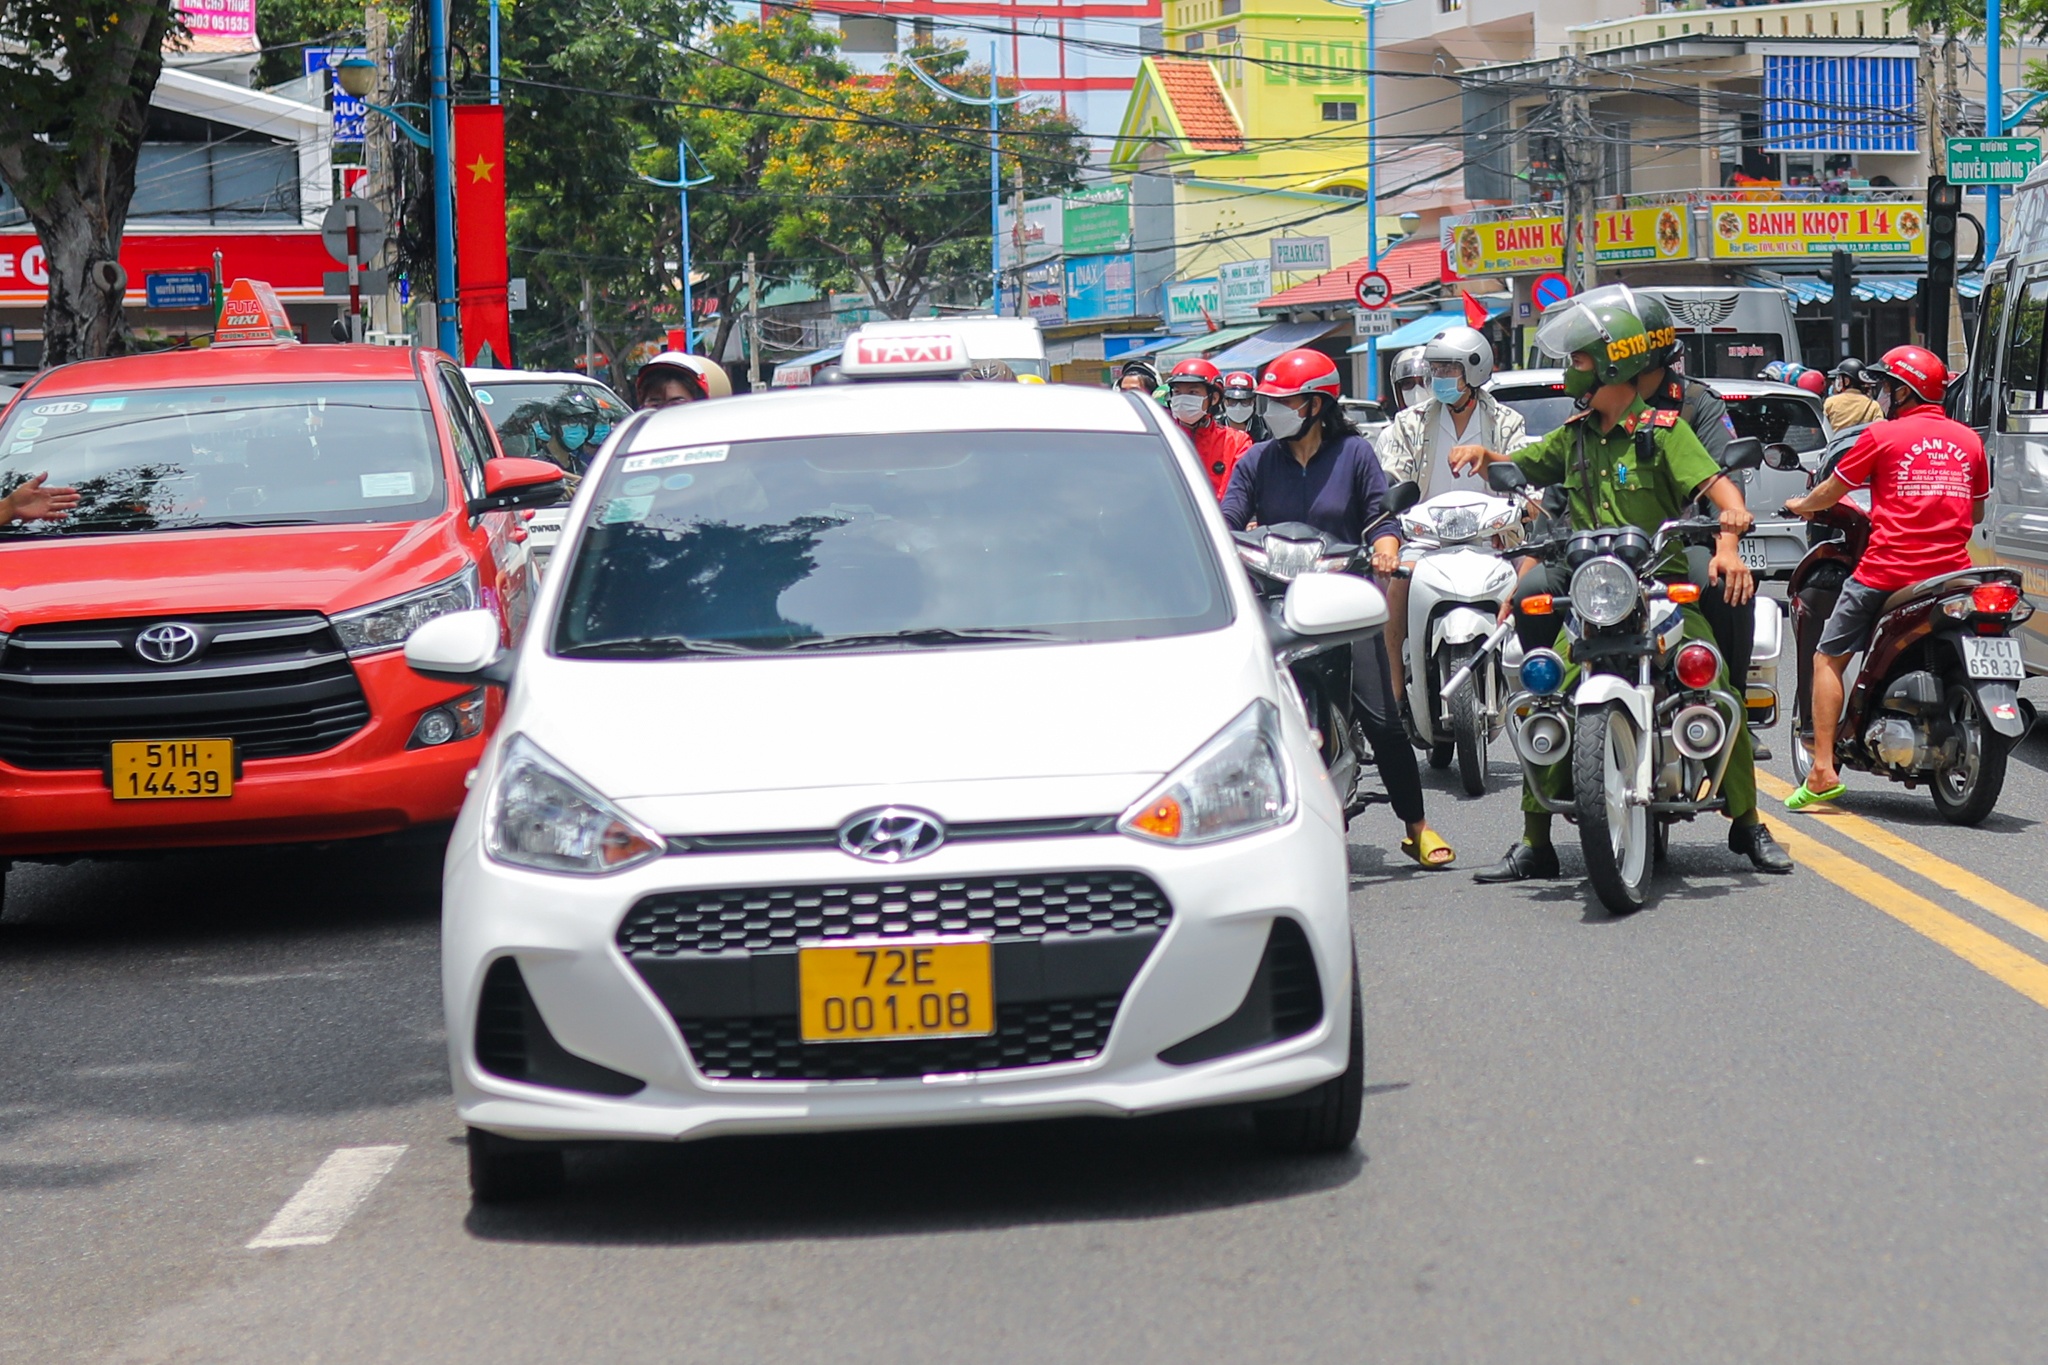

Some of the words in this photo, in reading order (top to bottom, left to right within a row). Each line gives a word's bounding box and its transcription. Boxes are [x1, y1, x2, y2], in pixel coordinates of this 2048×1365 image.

[1980, 140, 2009, 152] ĐƯỜNG
[1951, 156, 1988, 179] NGUYỄN
[1990, 156, 2024, 179] TRƯỜNG
[1496, 222, 1545, 252] BÁNH
[1607, 213, 1635, 243] 14
[1747, 206, 1796, 236] BÁNH
[1802, 211, 1850, 242] KHỌT
[1856, 208, 1893, 236] 14
[1277, 243, 1325, 264] PHARMACY
[1076, 264, 1098, 286] INAX
[226, 300, 262, 315] FUTA
[1172, 288, 1201, 316] THUỐC
[226, 314, 261, 326] TAXI
[860, 336, 948, 363] TAXI
[1606, 332, 1648, 362] CS113
[37, 403, 82, 414] 0115
[1911, 437, 1943, 456] SẢN
[1972, 640, 2013, 658] 72-C1
[1970, 659, 2022, 677] 658.32
[146, 744, 197, 768] 51H
[129, 770, 220, 796] 144.39
[855, 948, 936, 987] 72E
[824, 991, 970, 1032] 001.08
